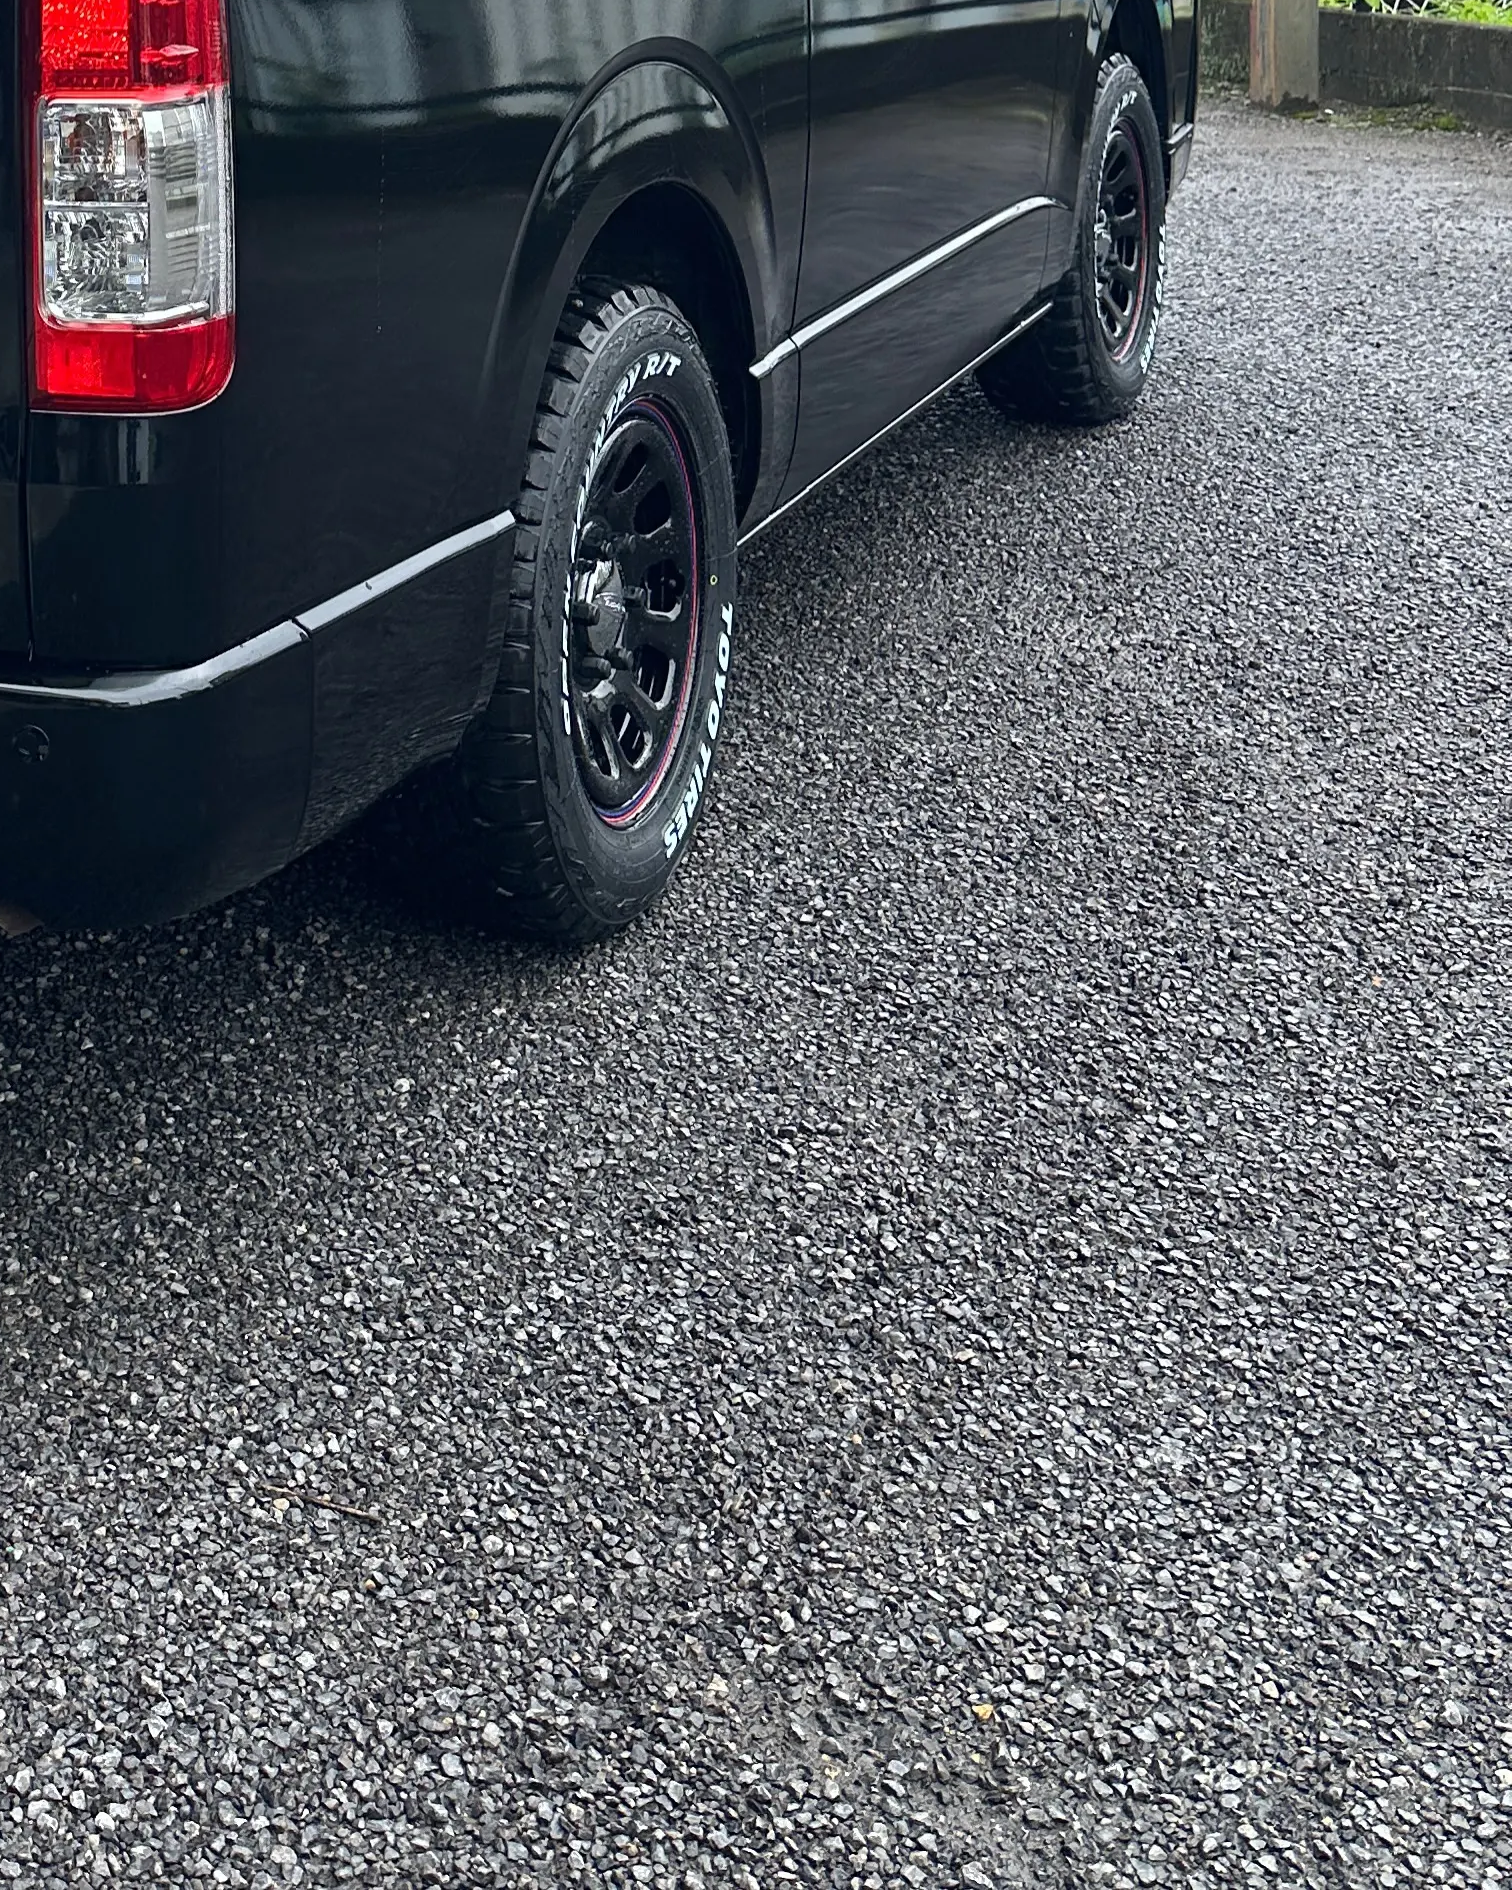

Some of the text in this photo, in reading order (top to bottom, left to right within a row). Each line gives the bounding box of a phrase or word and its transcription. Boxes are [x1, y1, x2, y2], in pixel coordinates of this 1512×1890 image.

[643, 352, 681, 379] R/T
[663, 601, 733, 859] TOYO TIRES
